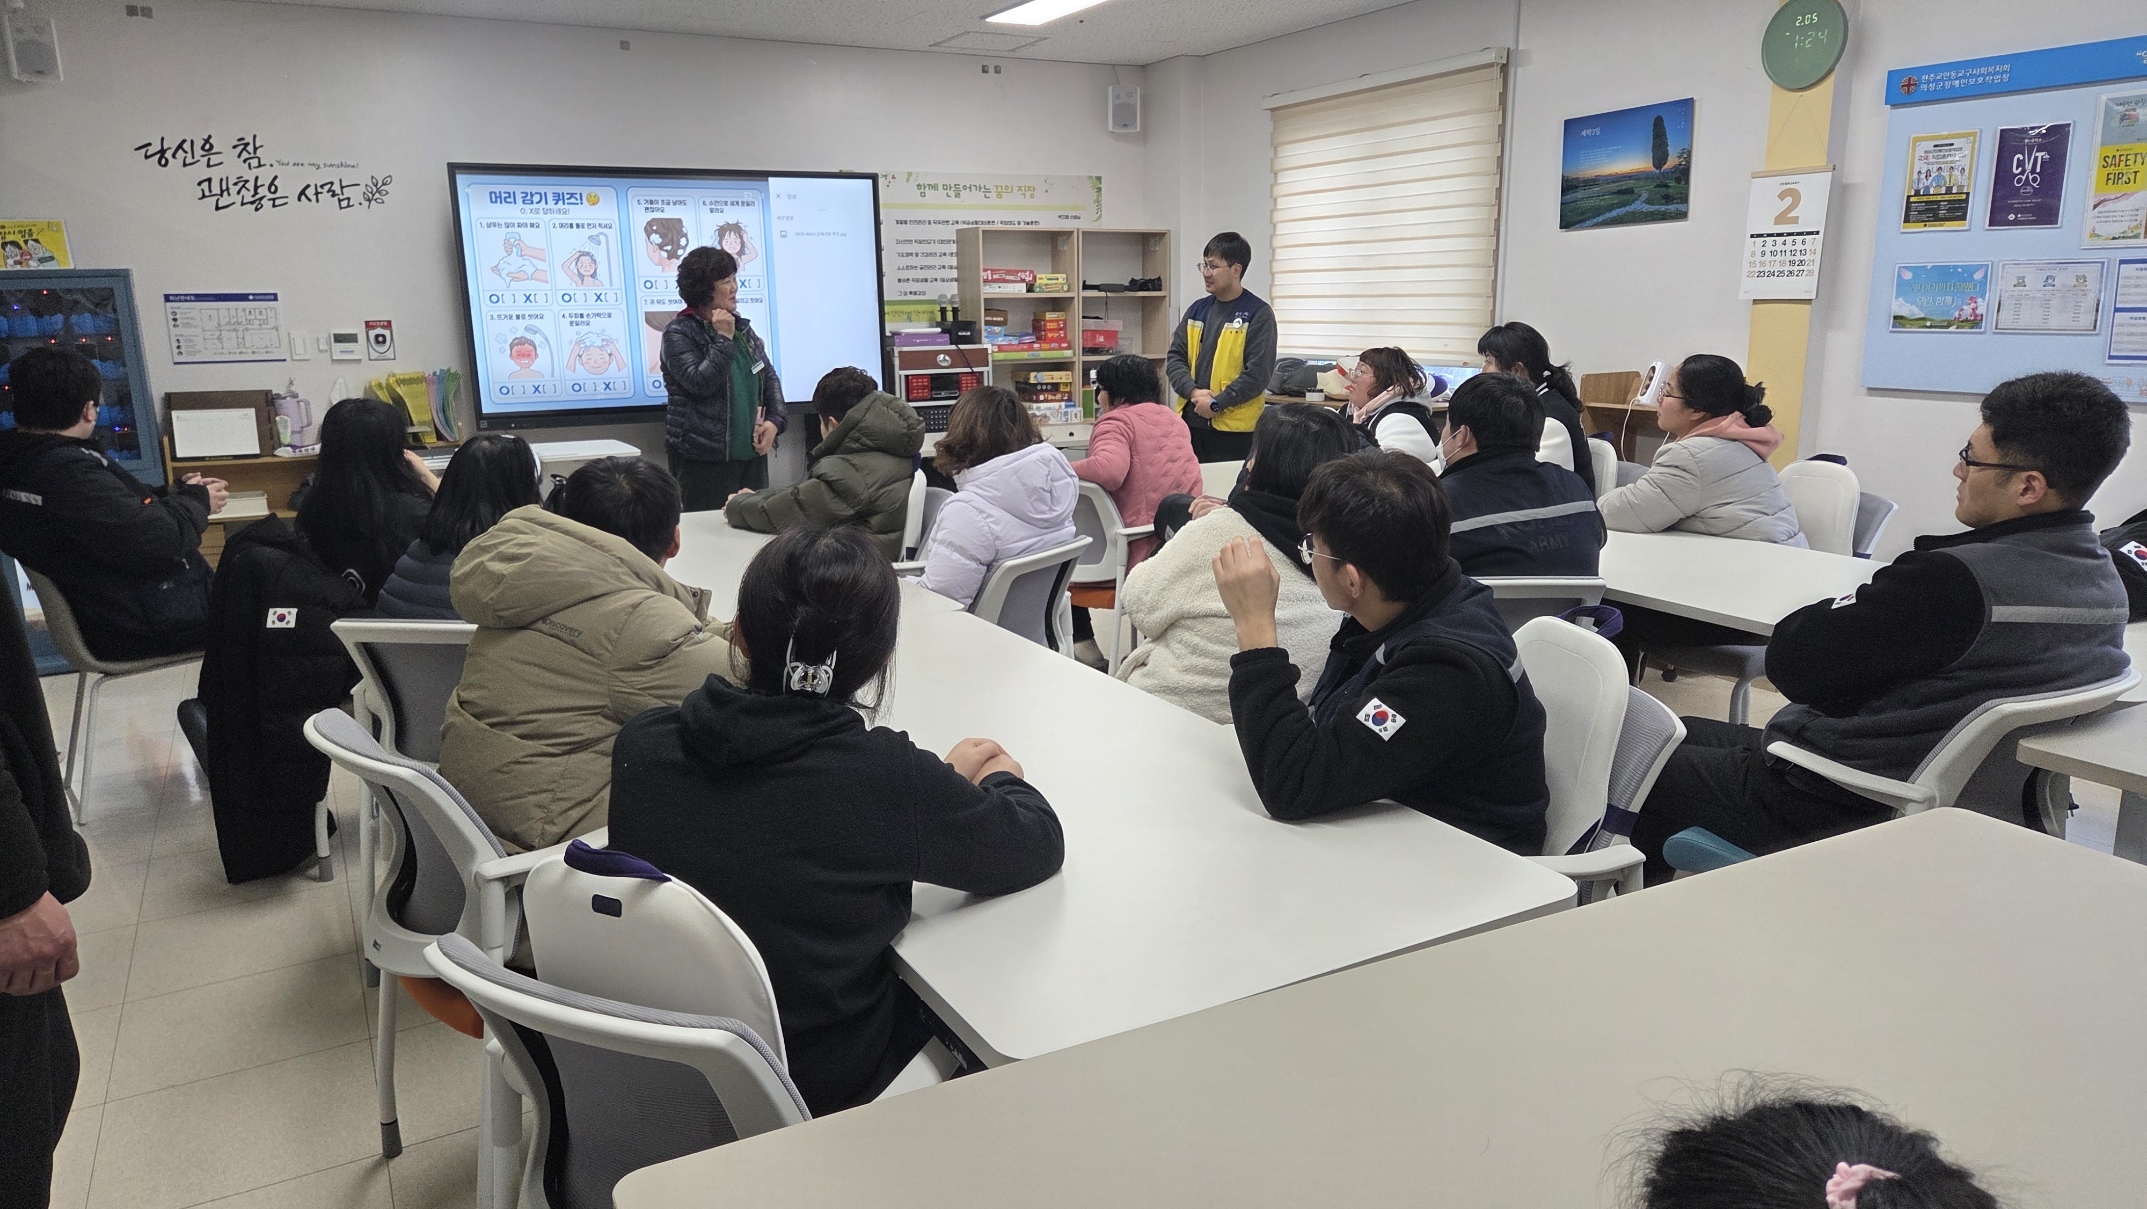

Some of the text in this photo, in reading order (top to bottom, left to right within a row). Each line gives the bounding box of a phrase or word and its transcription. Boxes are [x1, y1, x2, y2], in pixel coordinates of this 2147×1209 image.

[1796, 13, 1818, 26] 2.05
[1795, 29, 1828, 49] 1:24
[1921, 64, 2011, 83] 천주교안동교구사회복지회
[1920, 74, 2010, 92] 의성군장애인보호작업장
[134, 134, 274, 170] 당신은 참.
[2102, 152, 2147, 169] SAFETY
[2105, 170, 2140, 186] FIRST
[197, 175, 363, 212] 괜찮은 사람.
[489, 191, 584, 206] 머리 감기 퀴즈!
[916, 183, 1036, 199] 함께 만들어가는 꿈의 직장
[1773, 187, 1802, 226] 2
[1750, 250, 1756, 258] 8
[1779, 249, 1787, 257] 11
[1758, 260, 1766, 268] 16
[541, 617, 584, 638] Discovery
